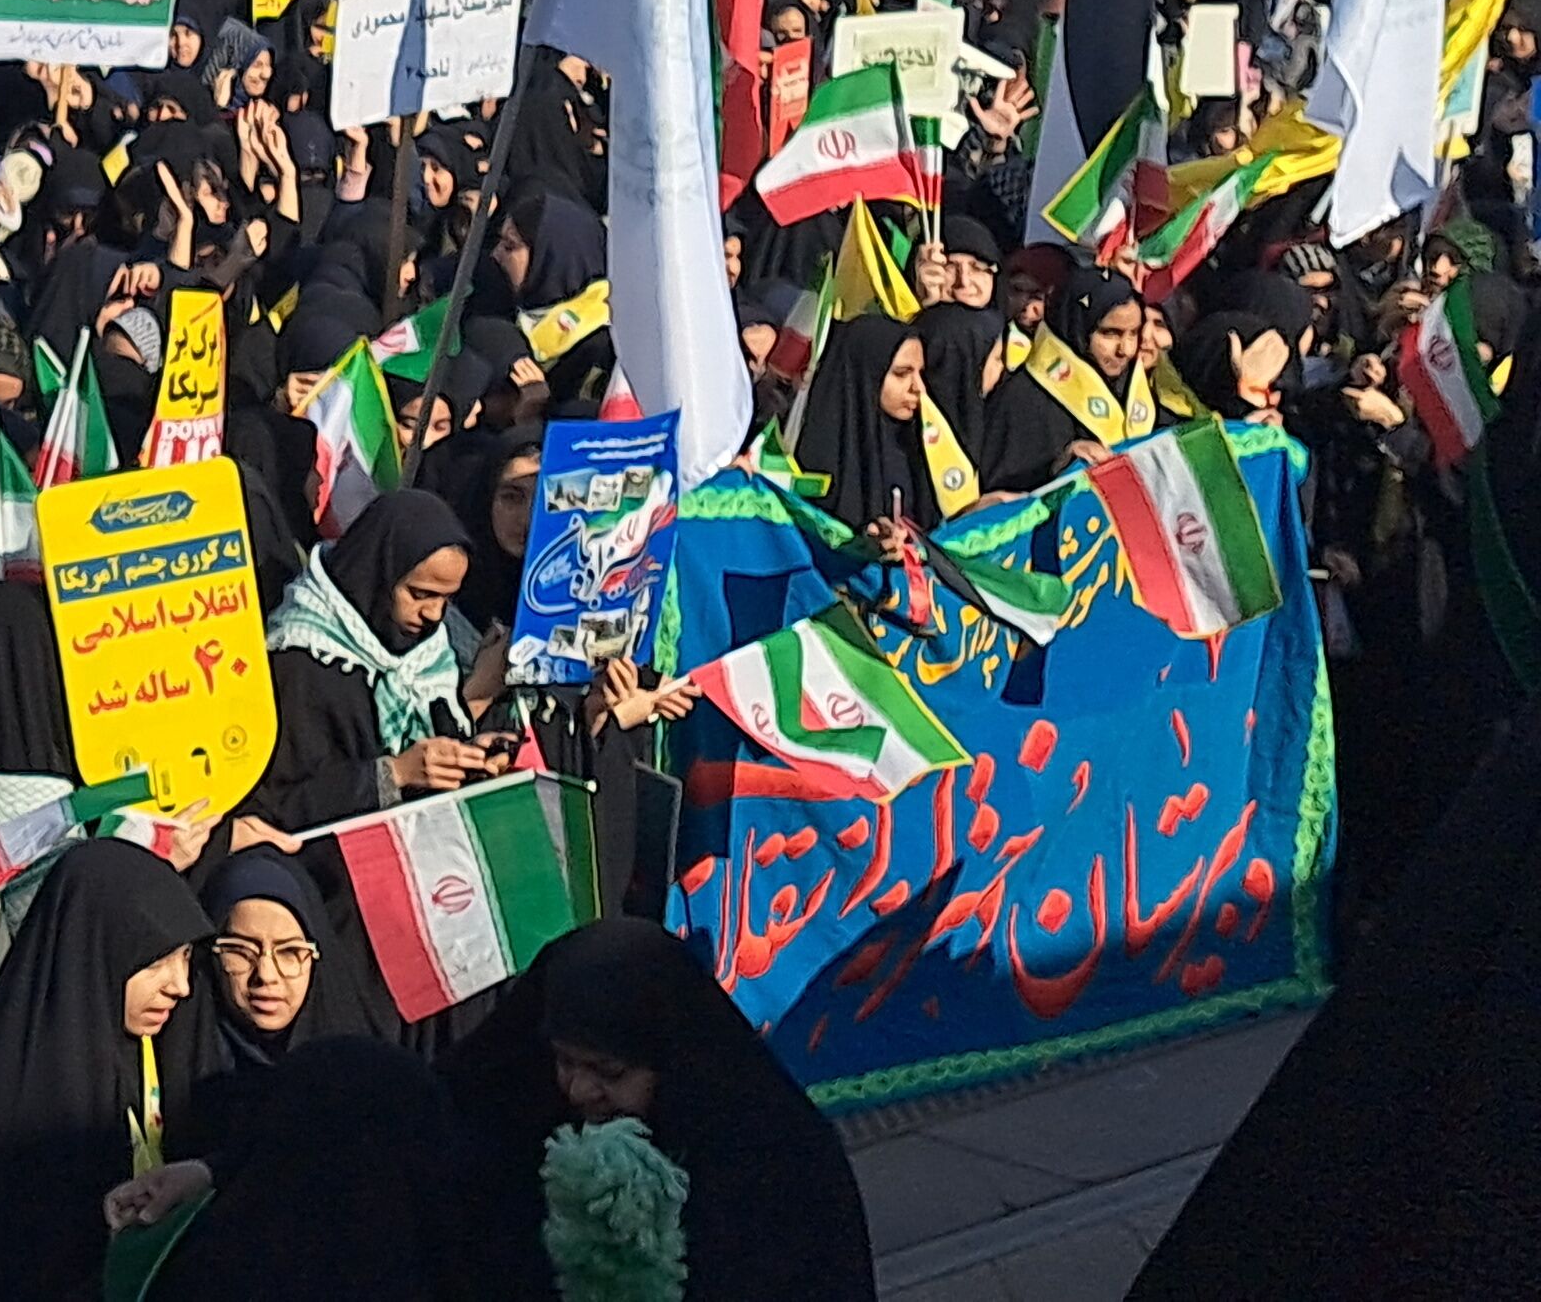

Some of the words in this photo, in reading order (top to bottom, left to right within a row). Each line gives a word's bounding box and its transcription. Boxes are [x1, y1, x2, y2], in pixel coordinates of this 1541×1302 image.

[168, 370, 220, 415] ریکا
[169, 538, 220, 578] کوری
[222, 538, 242, 564] به
[58, 557, 121, 595] آمریکا
[123, 556, 168, 587] چشم
[170, 579, 248, 634] انقلاب
[72, 597, 167, 655] اسلامی
[88, 680, 129, 717] شد
[134, 669, 190, 703] ساله
